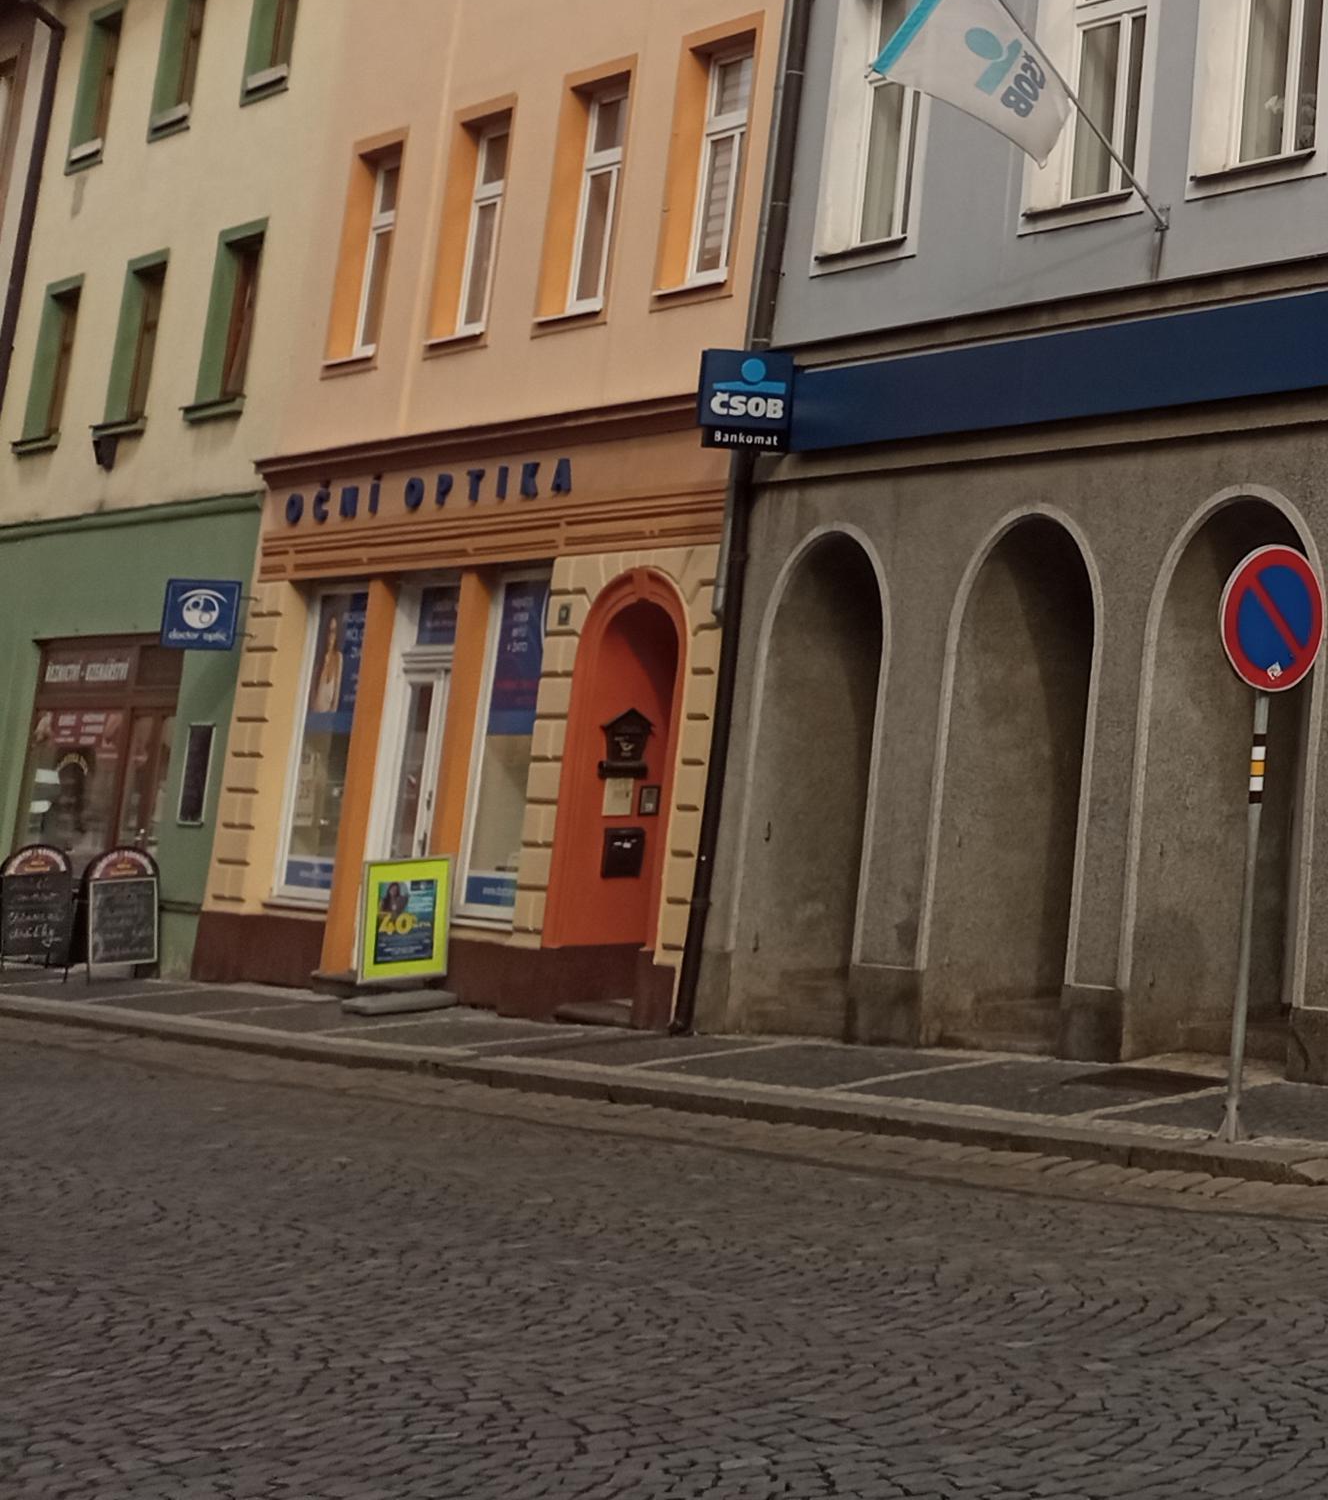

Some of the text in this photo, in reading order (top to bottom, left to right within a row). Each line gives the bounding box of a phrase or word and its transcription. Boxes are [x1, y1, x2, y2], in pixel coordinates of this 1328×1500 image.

[710, 391, 784, 419] ČSOB
[714, 430, 778, 445] Bankomat
[285, 458, 572, 527] OČNÍ OPTIKA
[168, 628, 228, 642] doctor optic
